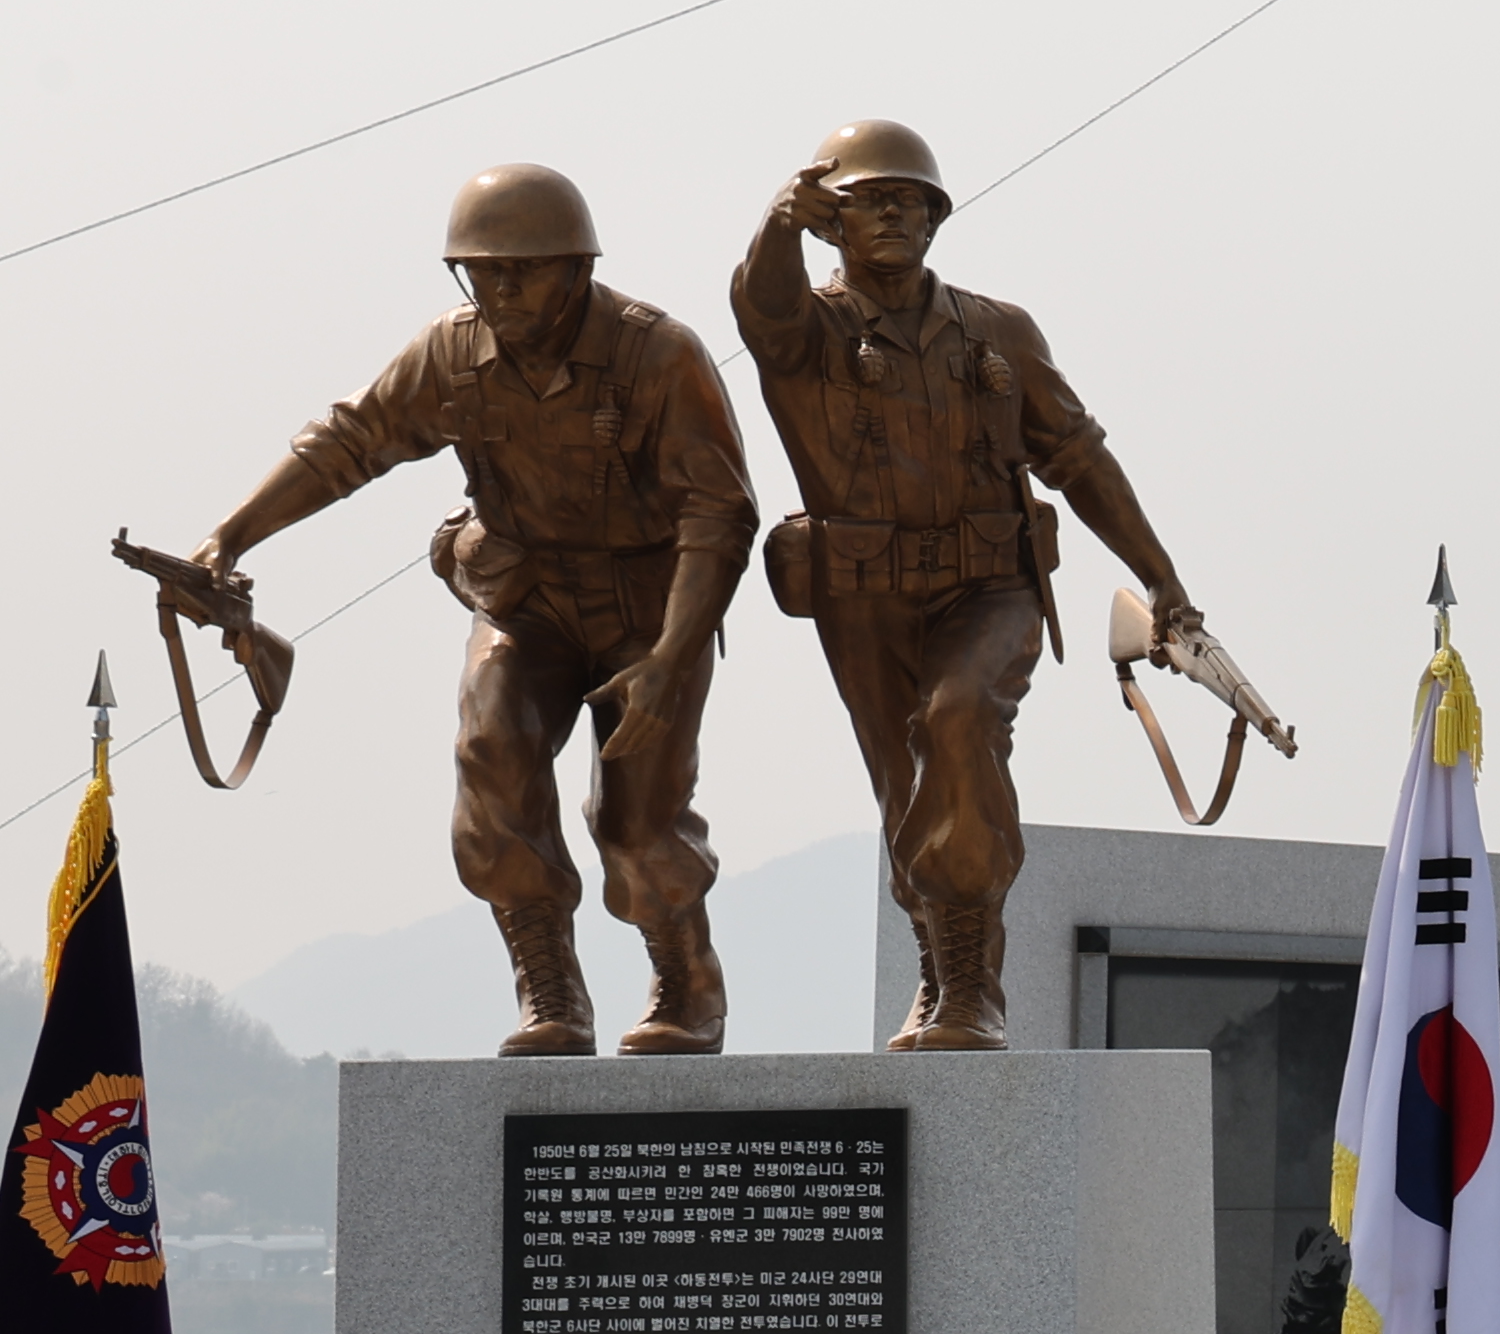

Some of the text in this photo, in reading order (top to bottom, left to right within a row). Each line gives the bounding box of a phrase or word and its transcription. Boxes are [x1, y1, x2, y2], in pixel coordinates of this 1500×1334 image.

[532, 1270, 883, 1290] 전쟁 초기 개시된 이곳 <하동전투>는 미군 24사단 29연대
